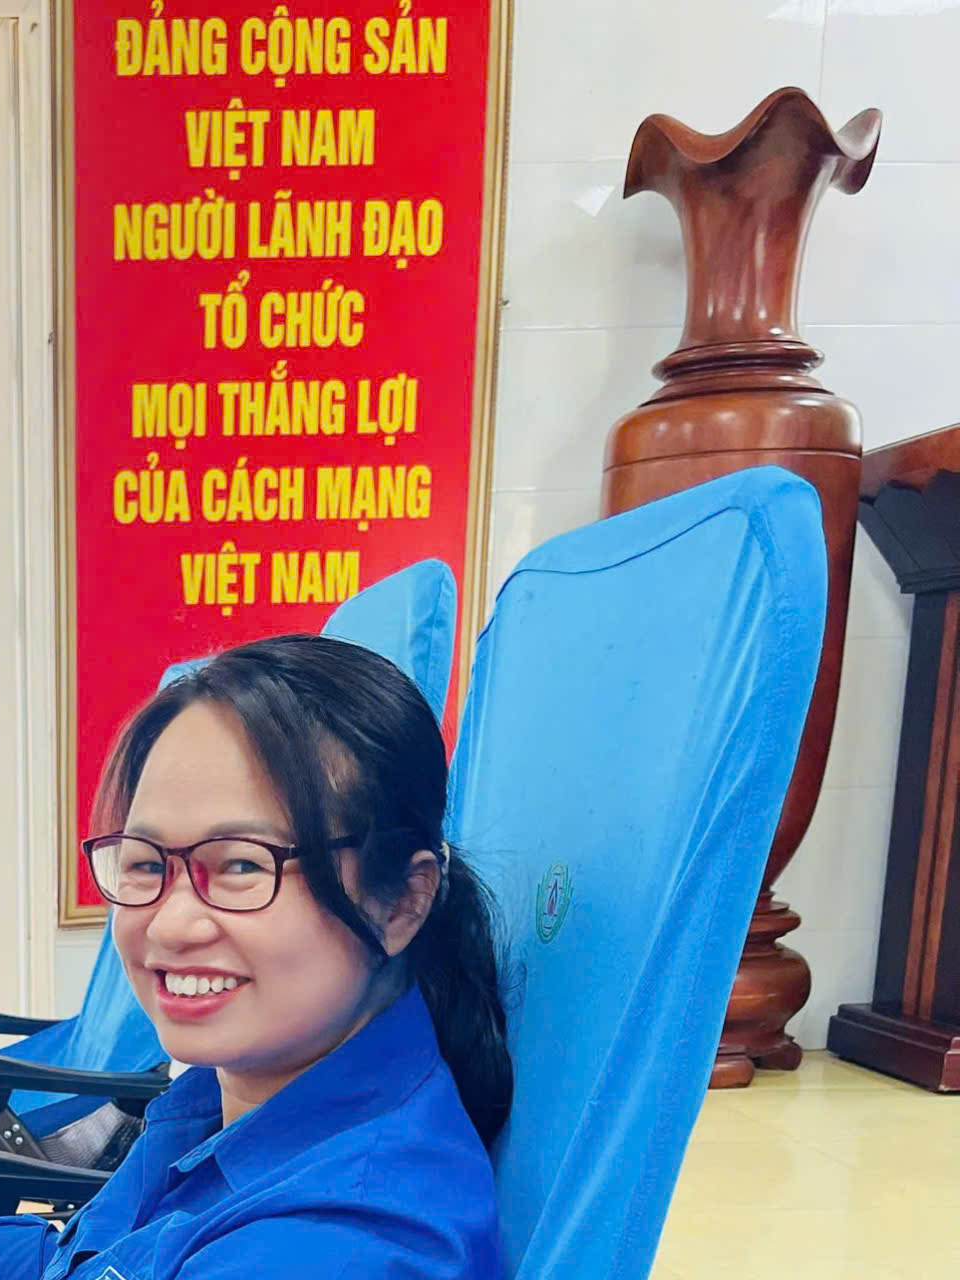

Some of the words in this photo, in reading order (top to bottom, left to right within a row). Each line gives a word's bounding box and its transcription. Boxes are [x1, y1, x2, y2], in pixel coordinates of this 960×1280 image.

[115, 0, 227, 76] ĐẢNG
[241, 5, 351, 88] CỘNG
[363, 0, 447, 75] SẢN
[185, 98, 270, 180] VIỆT
[281, 110, 374, 166] NAM
[113, 188, 235, 261] NGƯỜI
[248, 189, 351, 259] LÃNH
[362, 200, 443, 269] ĐẠO
[200, 270, 250, 349] TỔ
[260, 279, 365, 348] CHỨC
[132, 384, 206, 449] MỌI
[219, 360, 345, 437] THẮNG
[357, 372, 417, 445] LỢI
[113, 452, 190, 524] CỦA
[201, 456, 304, 521] CÁCH
[316, 465, 430, 531] MẠNG
[181, 541, 260, 616] VIỆT
[271, 551, 359, 605] NAM
